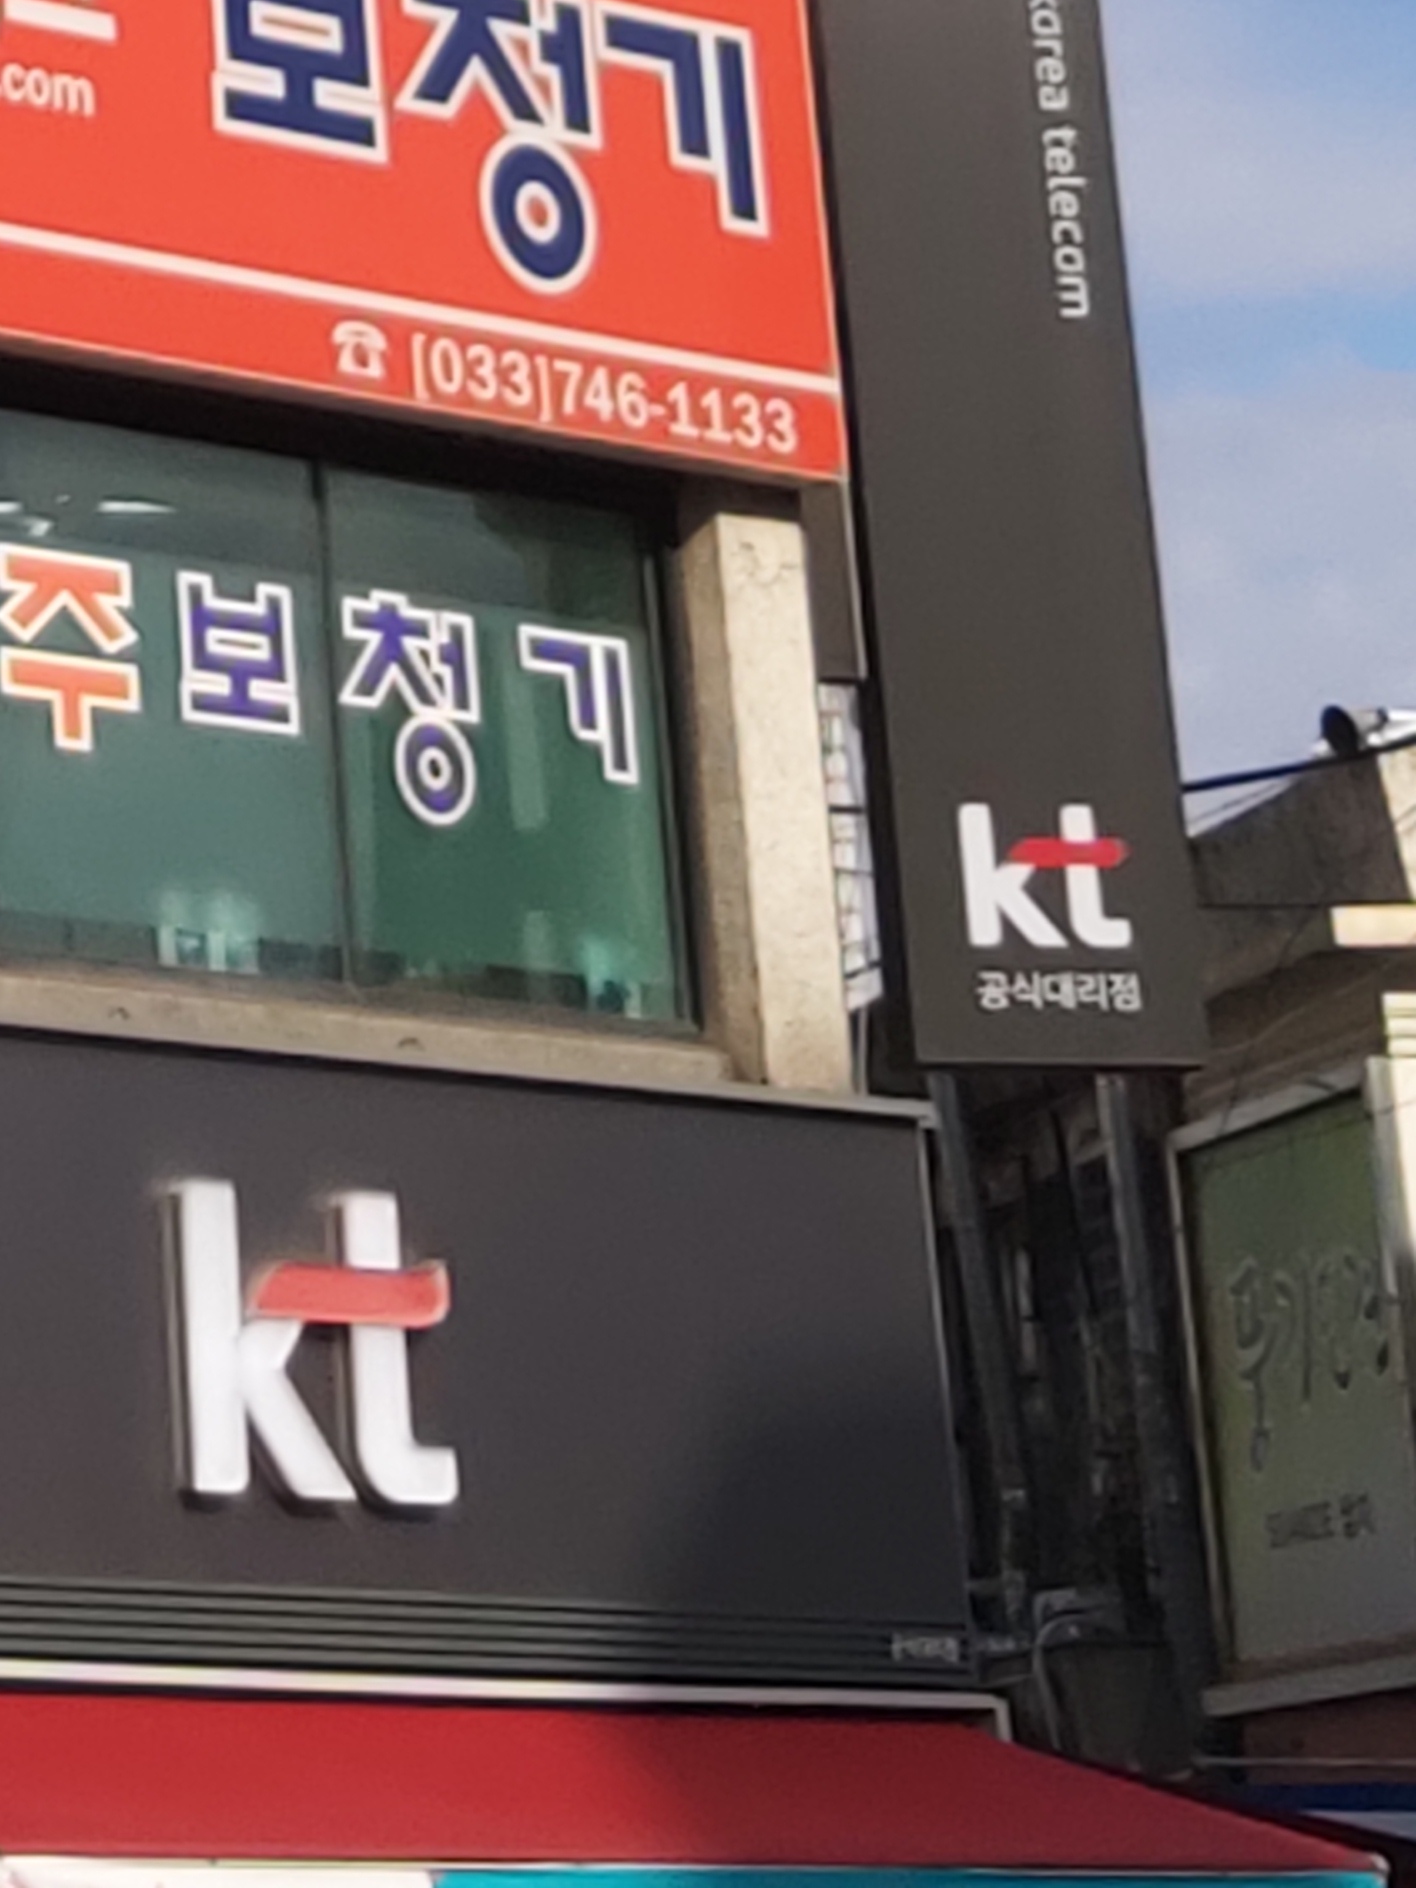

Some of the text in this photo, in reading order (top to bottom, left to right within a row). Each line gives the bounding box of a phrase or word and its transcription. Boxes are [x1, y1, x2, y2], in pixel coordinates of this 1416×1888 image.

[1041, 125, 1091, 319] telecom
[176, 568, 639, 826] 보청기
[958, 802, 1133, 949] kt
[975, 970, 1143, 1012] 공식대리점
[166, 1176, 460, 1508] kt
